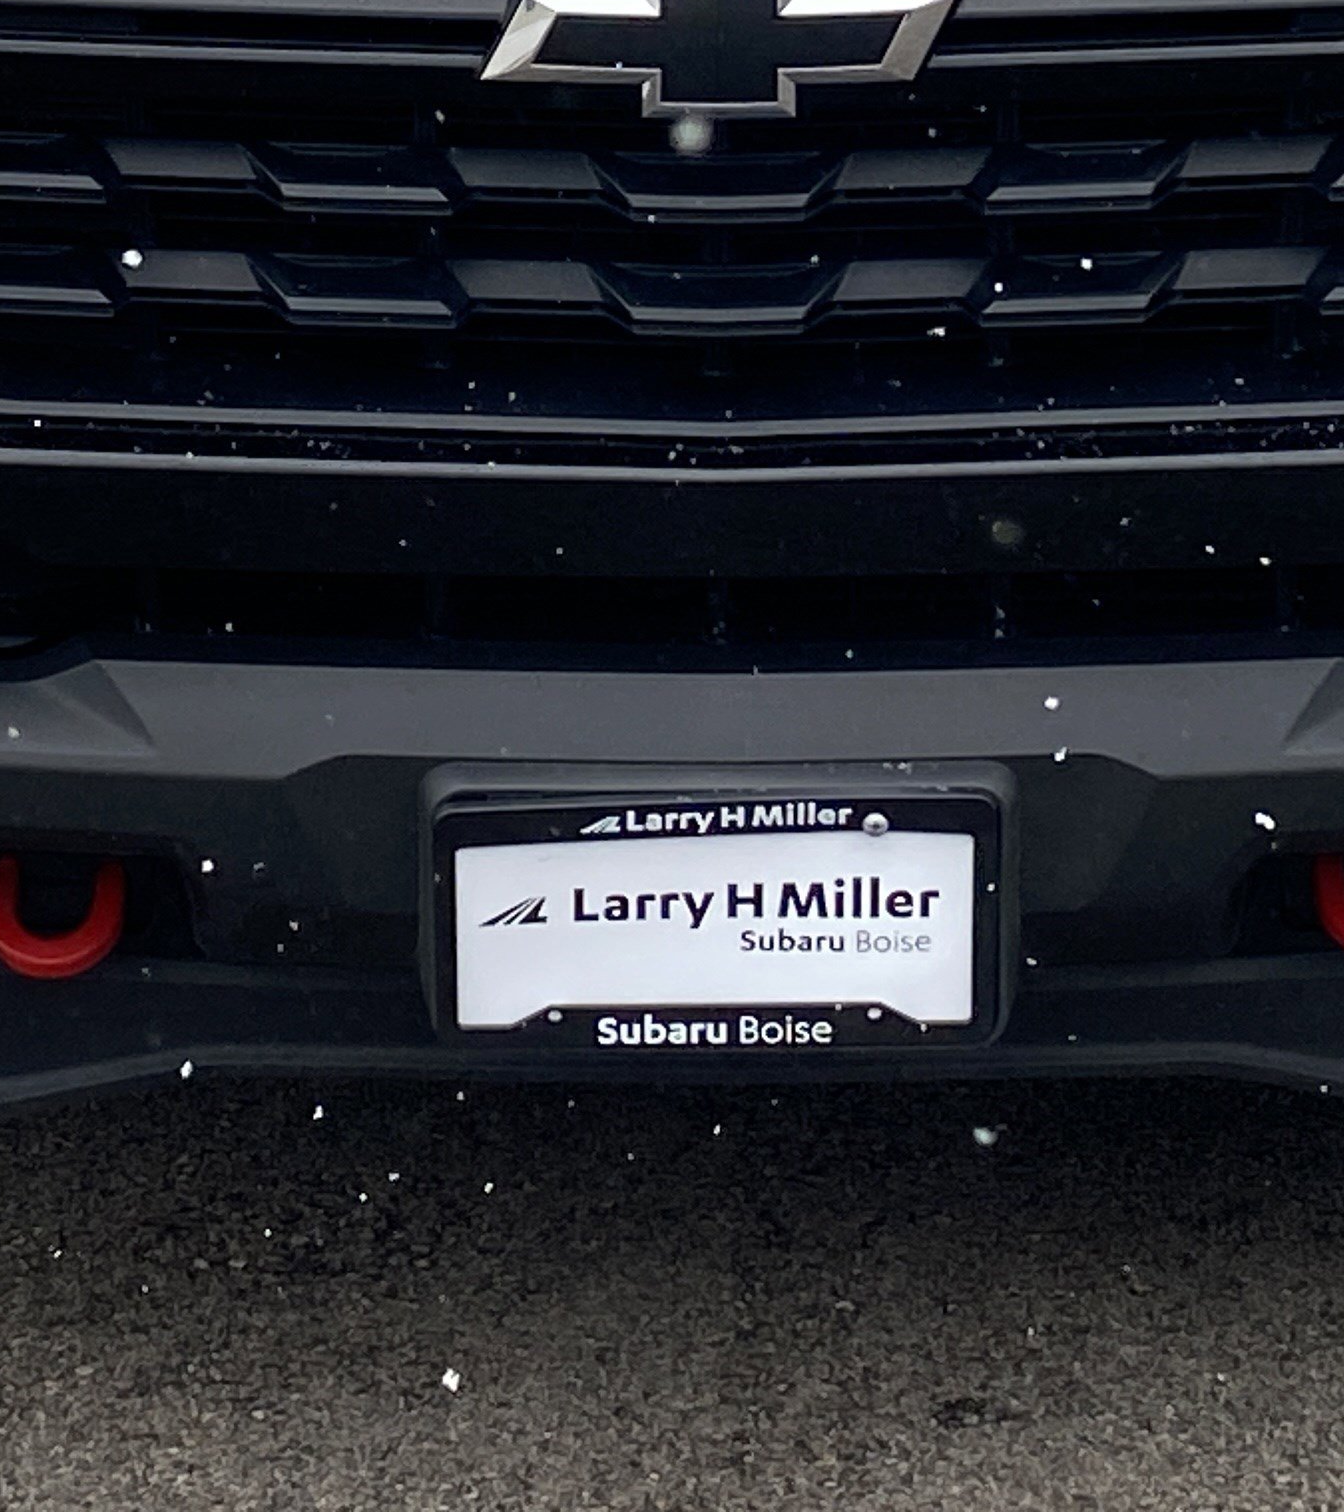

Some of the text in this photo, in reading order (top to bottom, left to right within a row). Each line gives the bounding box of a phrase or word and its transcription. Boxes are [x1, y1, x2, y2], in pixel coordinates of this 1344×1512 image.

[626, 801, 853, 833] Larry H Miller
[573, 876, 940, 929] Larry H Miller
[740, 928, 932, 953] Subaru Boise
[597, 1013, 833, 1045] Subaru Boise
